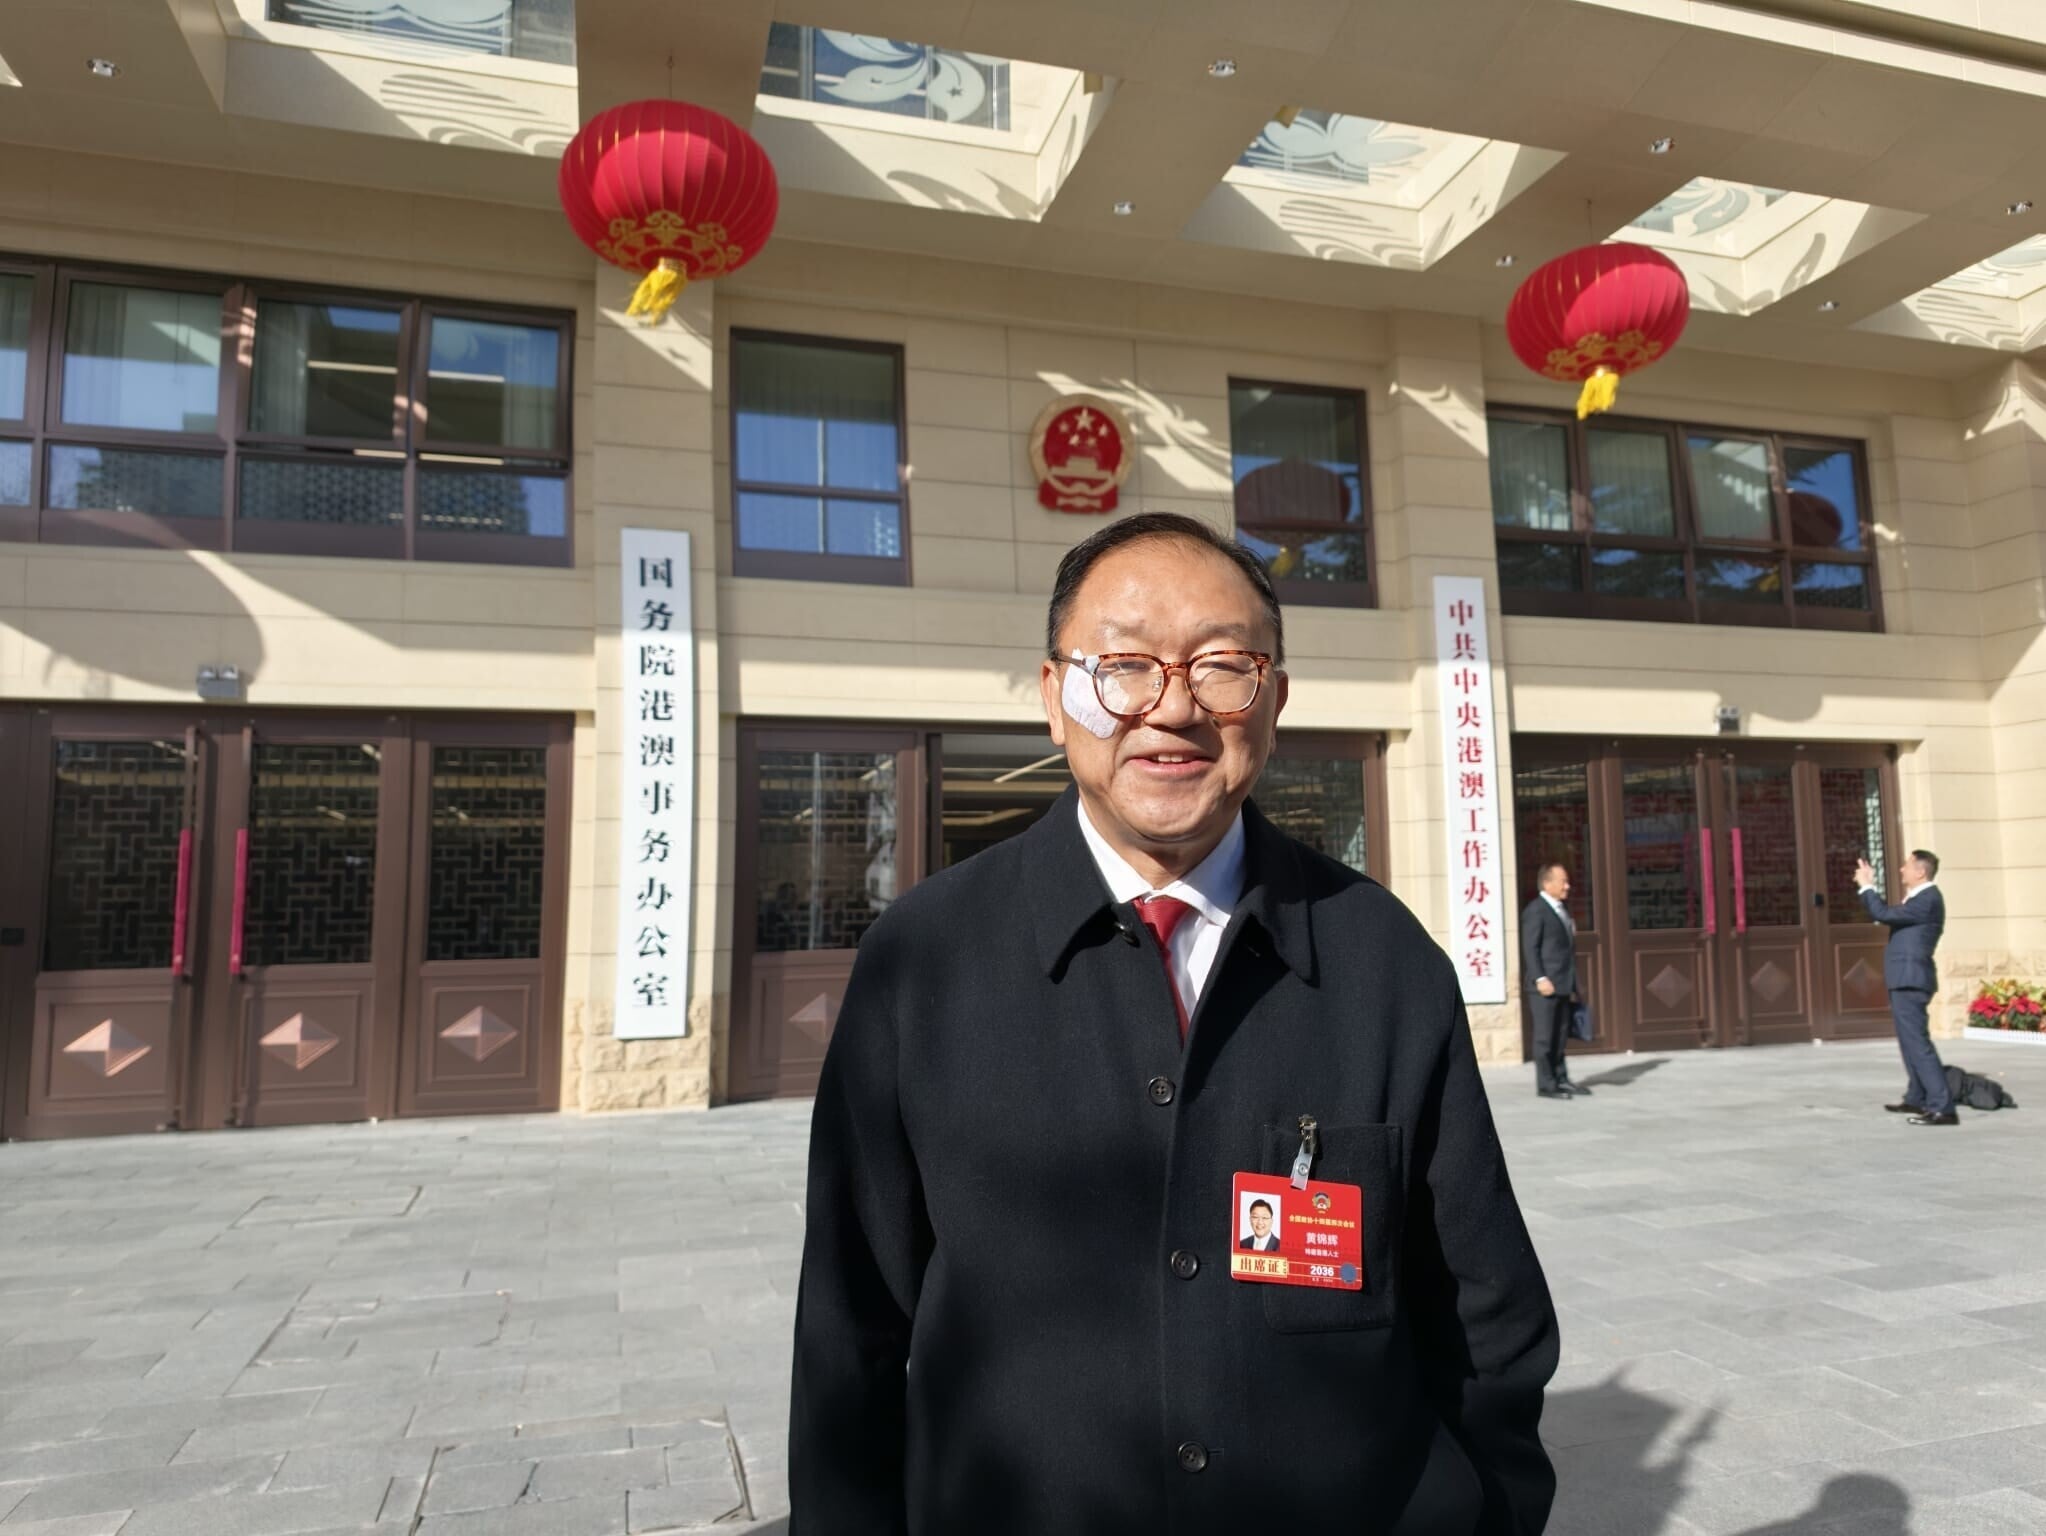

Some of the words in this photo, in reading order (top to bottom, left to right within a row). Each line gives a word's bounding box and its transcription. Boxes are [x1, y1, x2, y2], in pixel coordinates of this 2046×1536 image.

[632, 556, 675, 1007] 国务院港澳事务办公室
[1449, 598, 1493, 978] 中共中央港澳工作办公室
[1310, 1265, 1334, 1277] 2036
